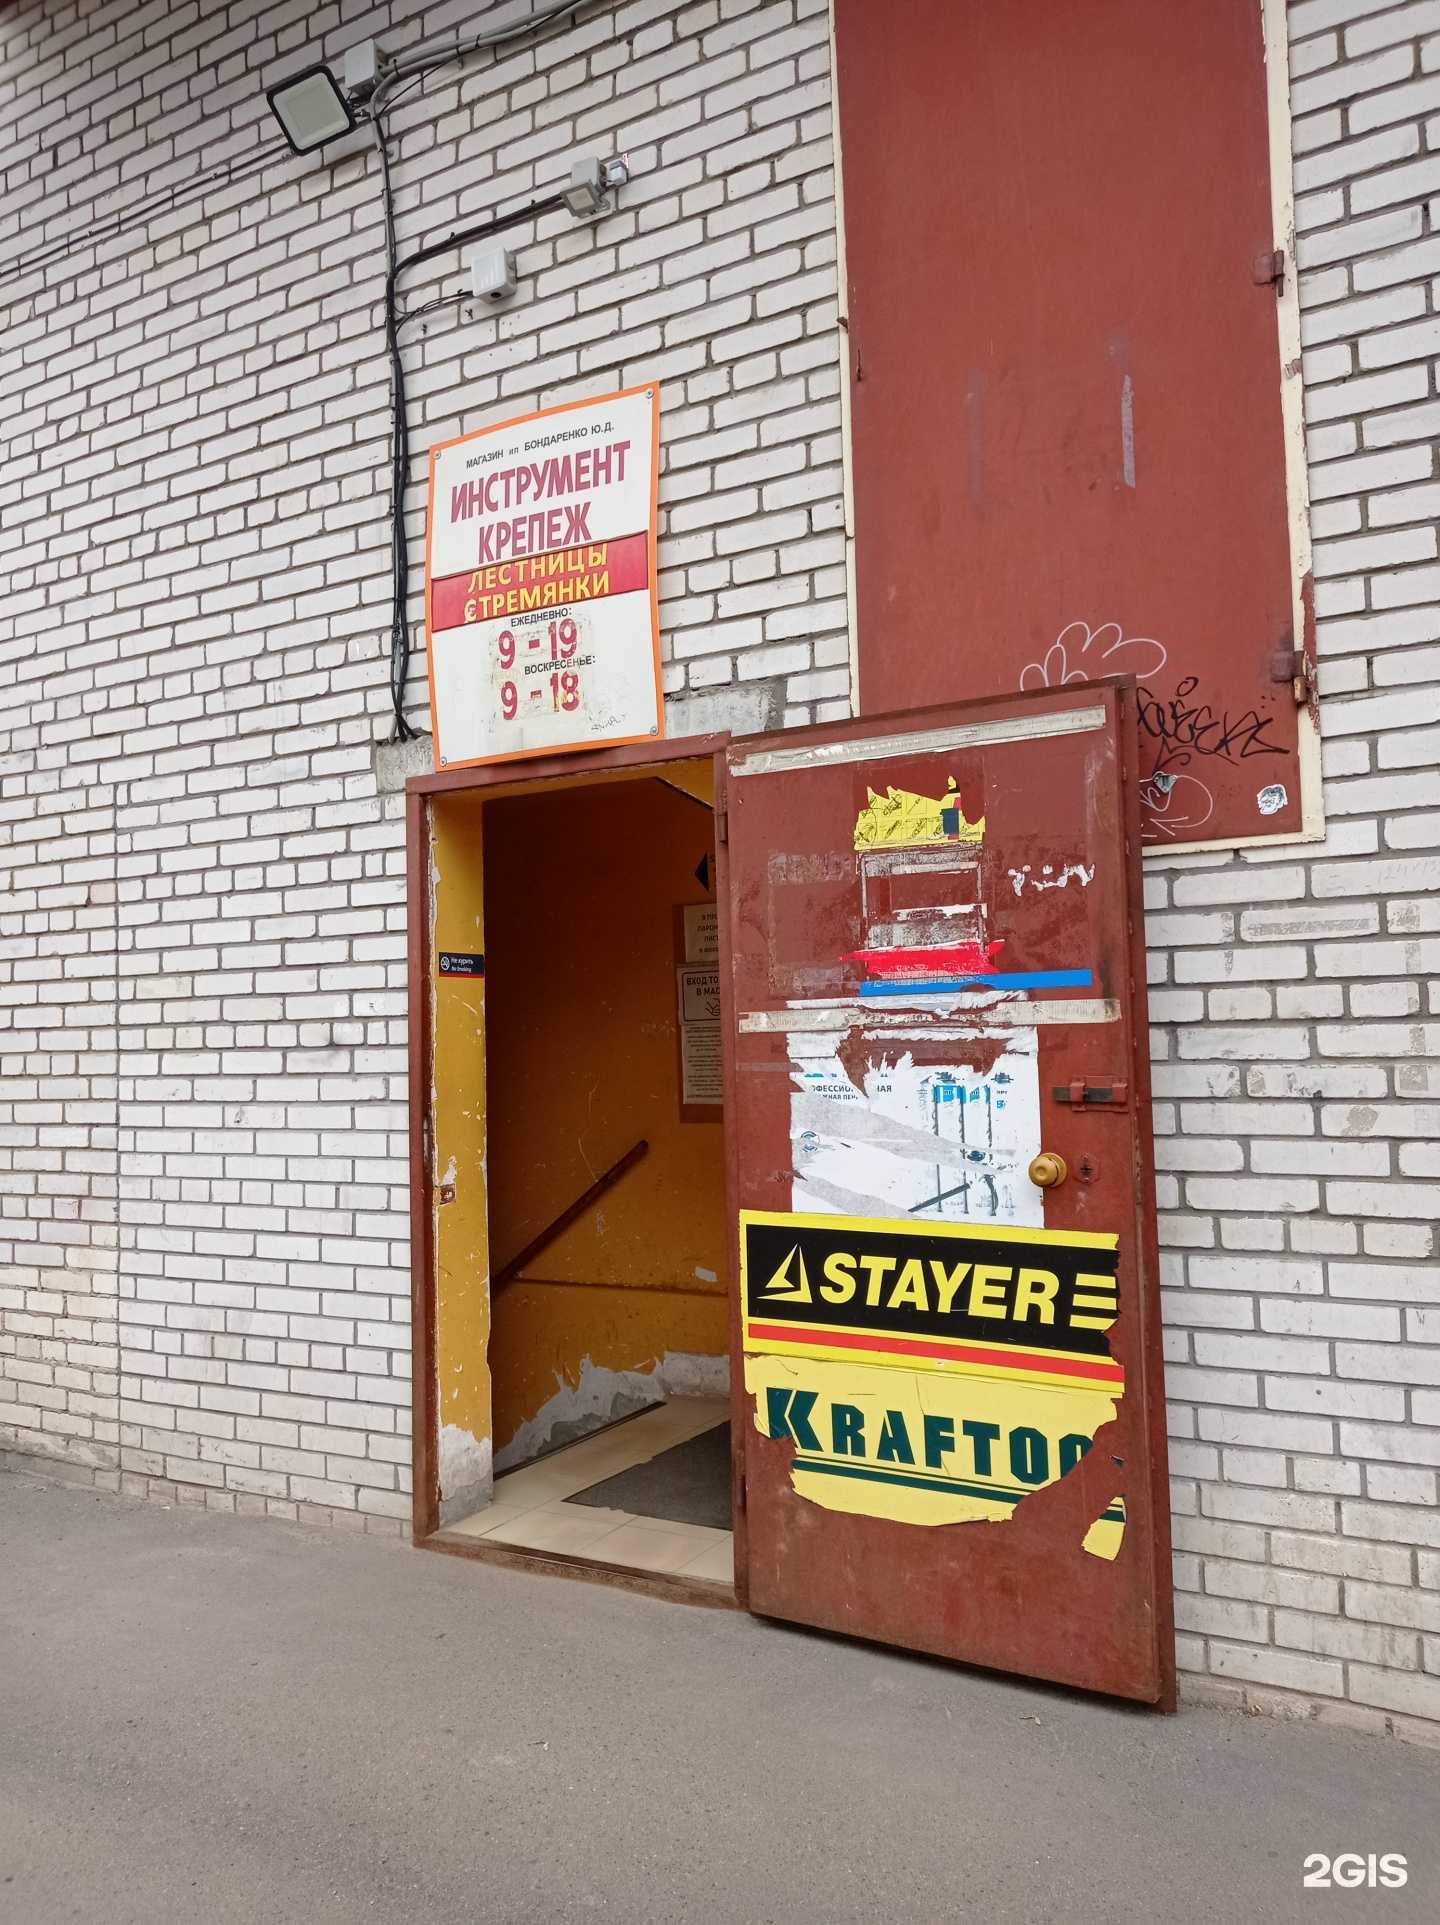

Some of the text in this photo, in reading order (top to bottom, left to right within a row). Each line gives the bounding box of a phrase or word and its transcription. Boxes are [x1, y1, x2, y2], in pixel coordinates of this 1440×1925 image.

[466, 449, 504, 469] МАГАЗИН
[524, 427, 588, 451] БОНДАРЕНКО
[450, 440, 631, 523] ИНСТРУМЕНТ
[478, 502, 592, 564] КРЕПЕЖ
[467, 543, 608, 593] ЛЕСТНИЦЫ
[463, 570, 609, 623] СТРЕМЯНКИ
[511, 607, 572, 627] ЕЖЕДНЕВНО:
[498, 630, 516, 670] 9
[548, 618, 578, 661] 19
[524, 655, 596, 675] ВОСКРЕСЕНЬЕ:
[501, 681, 518, 720] 9
[550, 671, 580, 712] 18
[819, 1252, 1060, 1325] STAYER
